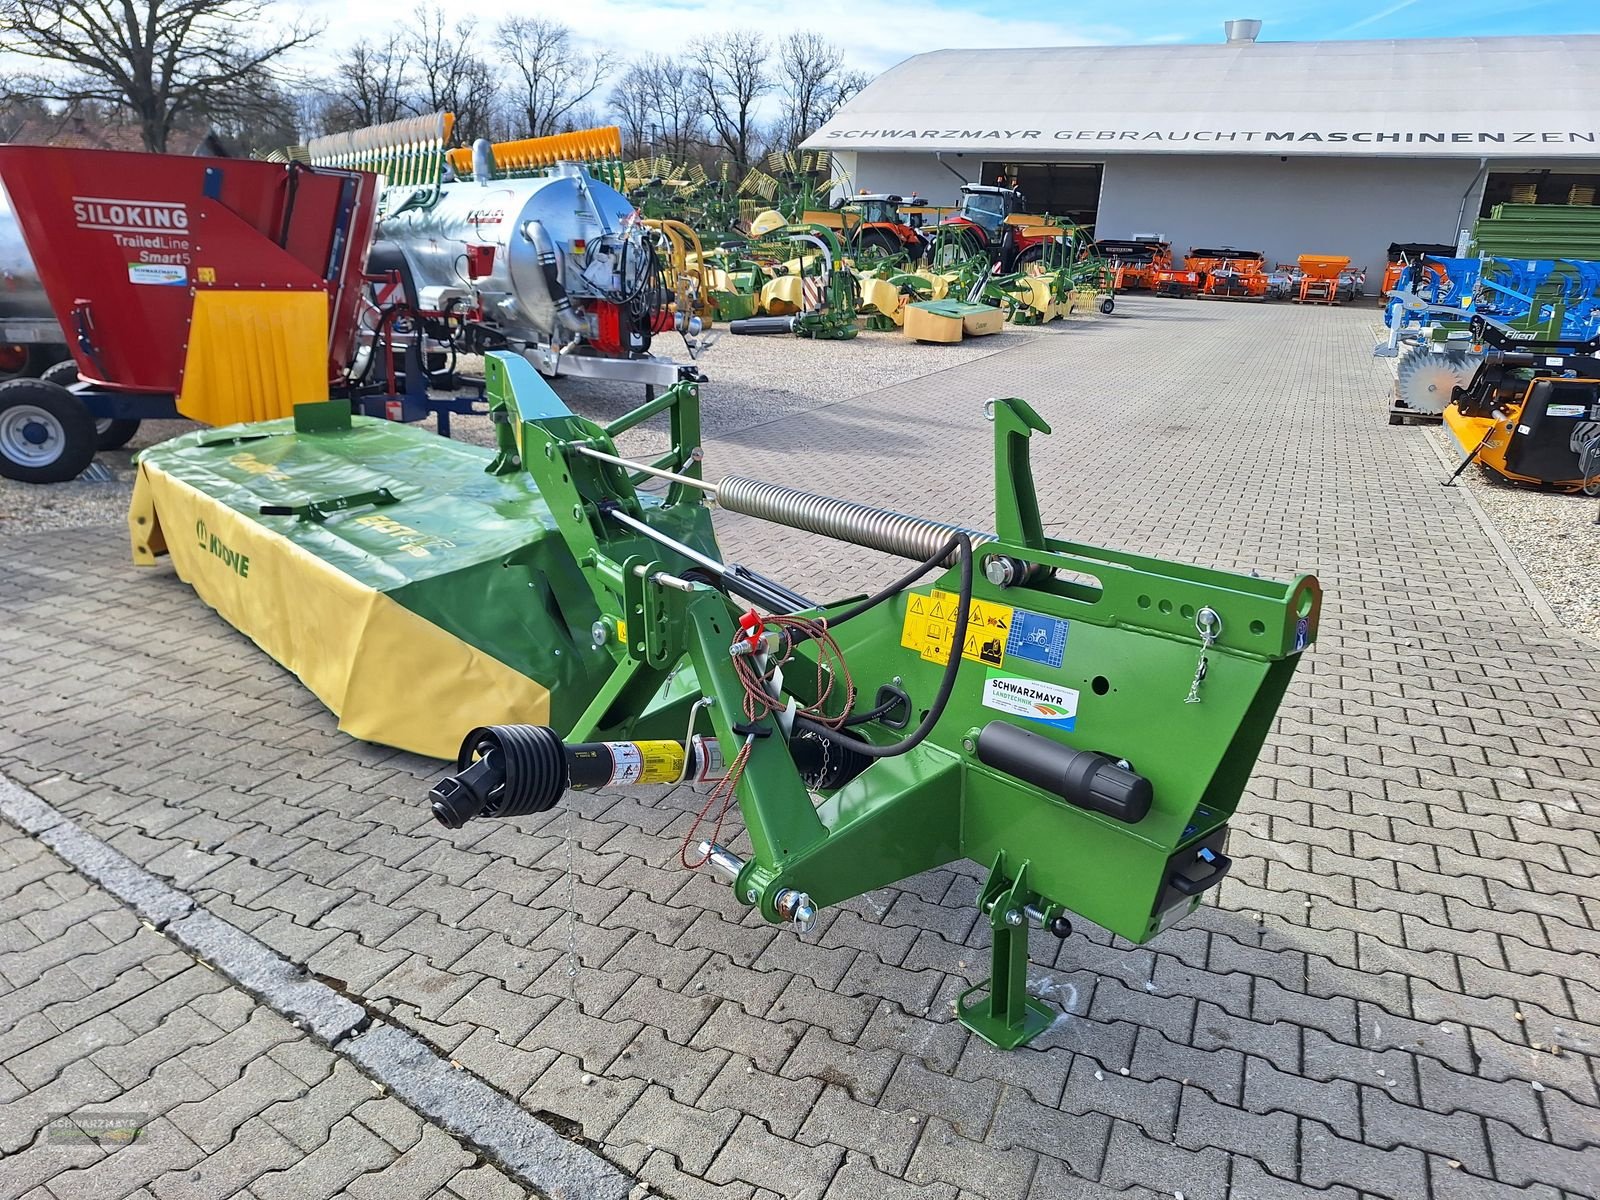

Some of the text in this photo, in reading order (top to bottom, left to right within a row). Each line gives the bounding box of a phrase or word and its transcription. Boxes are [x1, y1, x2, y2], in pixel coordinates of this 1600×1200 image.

[826, 129, 1042, 139] SCHWARZMAYR
[74, 203, 188, 228] SILOKING
[113, 233, 190, 250] TrailedLine
[992, 679, 1063, 706] SCHWARZMAYR
[992, 690, 1032, 706] LANDTECHNIK
